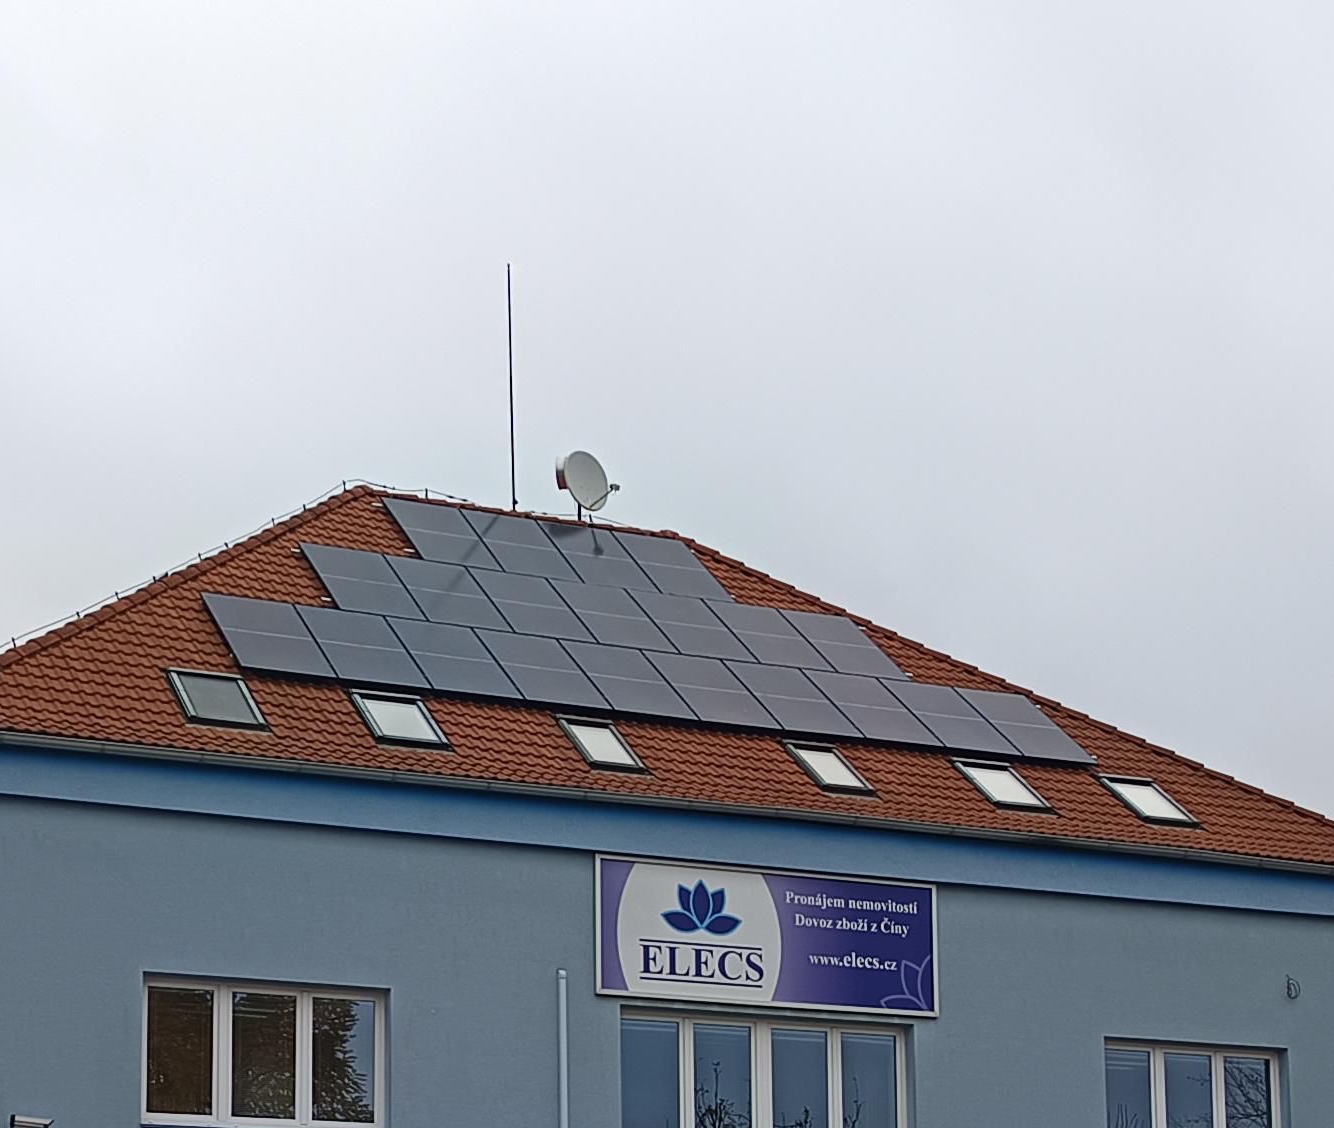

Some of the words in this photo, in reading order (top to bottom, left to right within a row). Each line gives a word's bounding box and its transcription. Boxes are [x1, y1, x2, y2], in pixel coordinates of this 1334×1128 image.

[785, 890, 845, 909] Pronájem
[848, 899, 918, 914] nemovitostí
[795, 913, 833, 929] Dovoz
[835, 917, 868, 932] zboží
[870, 922, 878, 932] z
[880, 917, 910, 938] Číny
[639, 943, 764, 983] ELECS
[809, 952, 898, 971] www.elecs.cz
